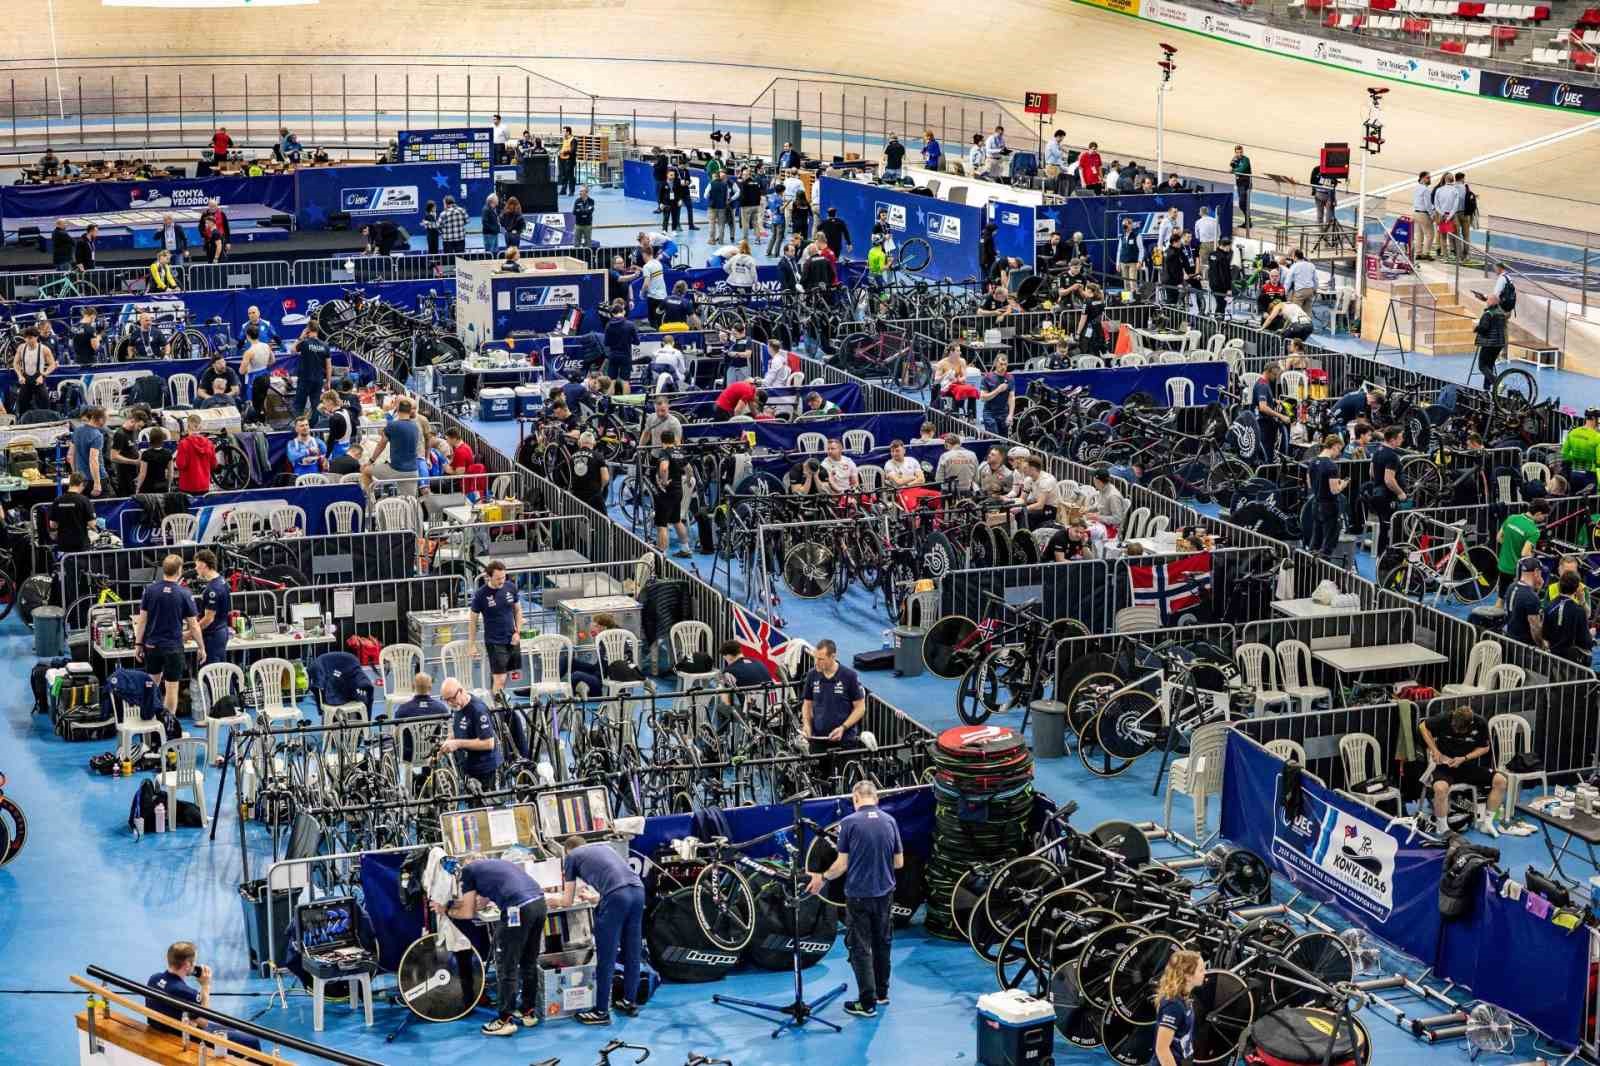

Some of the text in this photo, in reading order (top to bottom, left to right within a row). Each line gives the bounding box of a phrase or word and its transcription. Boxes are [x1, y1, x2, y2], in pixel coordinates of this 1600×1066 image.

[1513, 85, 1531, 96] UEC
[1028, 94, 1041, 108] 30
[1564, 93, 1584, 103] UEC
[172, 189, 204, 198] KONYA
[172, 196, 221, 206] VELODROE
[564, 360, 584, 369] UEC
[1294, 814, 1314, 834] UEC
[1333, 854, 1361, 880] KONYA
[1361, 871, 1387, 894] 2026
[685, 950, 738, 966] hope
